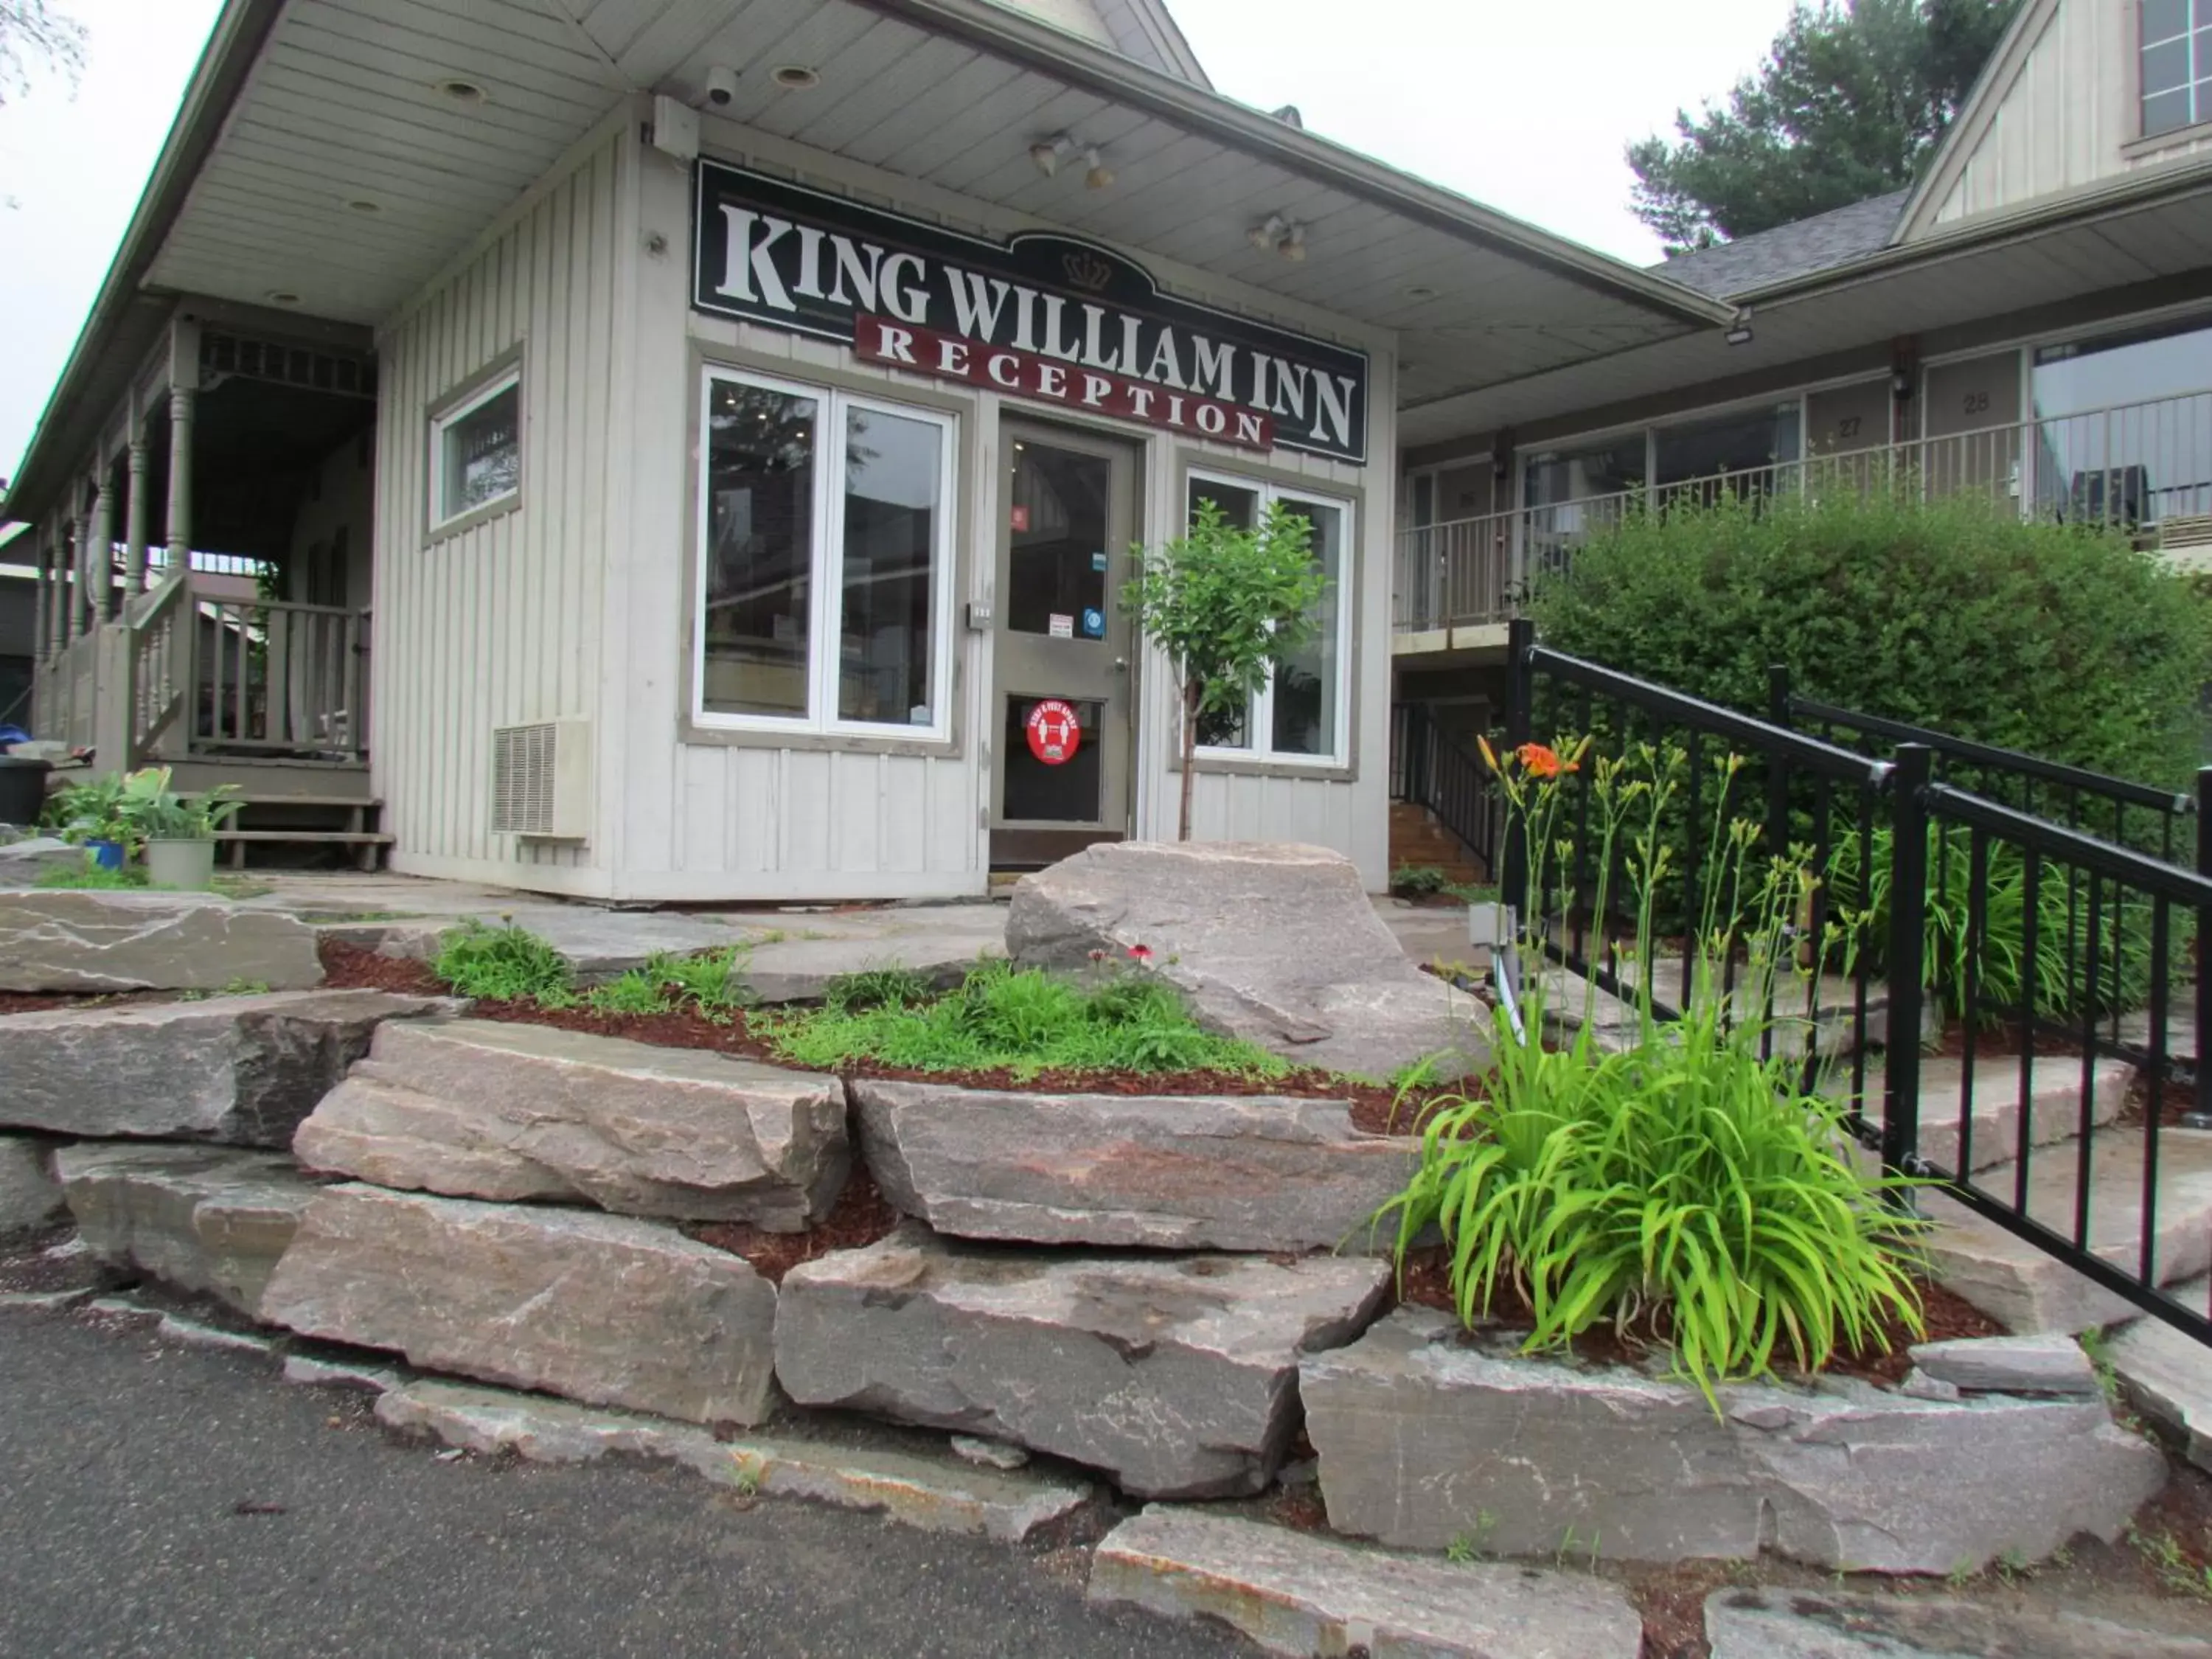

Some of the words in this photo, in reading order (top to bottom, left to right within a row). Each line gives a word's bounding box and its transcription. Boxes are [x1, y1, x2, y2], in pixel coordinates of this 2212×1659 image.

[714, 203, 931, 324] KING
[943, 265, 1237, 402] WILLIAM
[1248, 351, 1357, 448] INN
[875, 323, 1264, 443] RECEPTION
[1963, 391, 1989, 415] 28
[1839, 416, 1863, 438] 27
